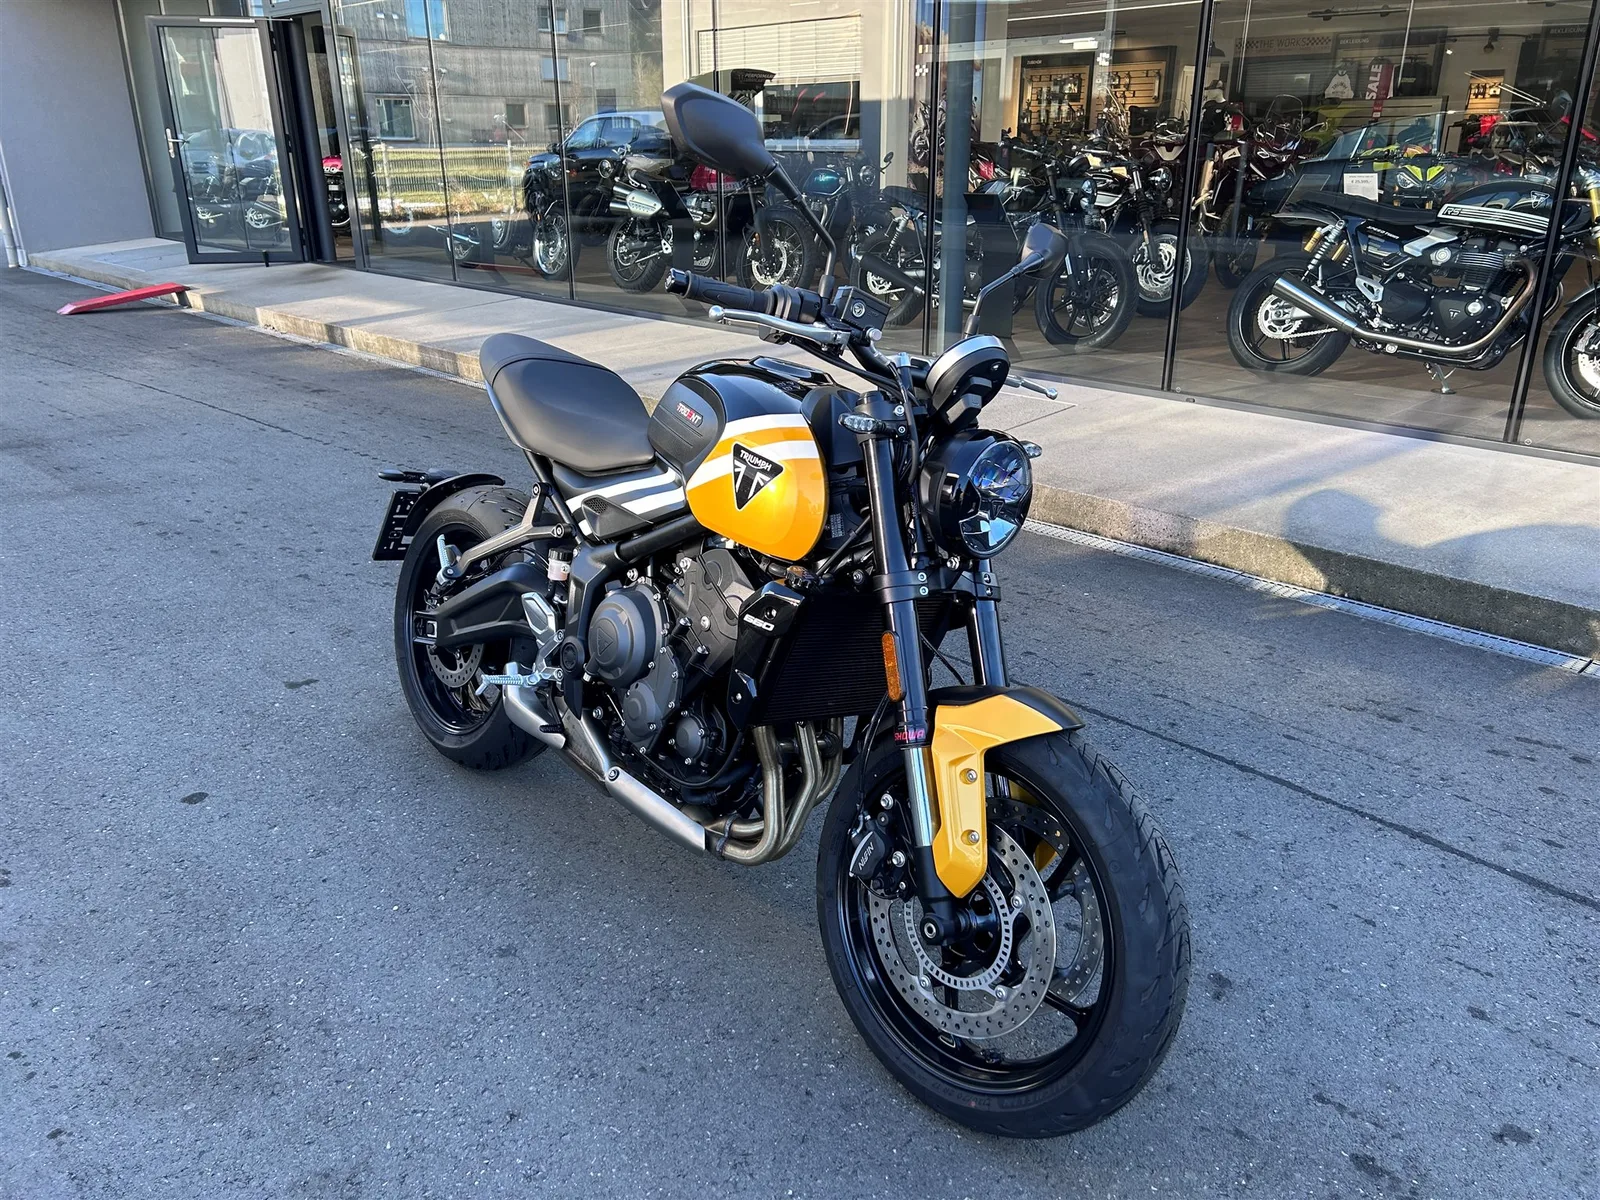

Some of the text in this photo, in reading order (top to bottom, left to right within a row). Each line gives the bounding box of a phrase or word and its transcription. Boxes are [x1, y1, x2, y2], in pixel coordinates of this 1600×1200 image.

[1259, 37, 1307, 48] THE WORKS
[1365, 64, 1383, 100] SALE
[1443, 207, 1462, 216] RS
[676, 402, 702, 424] TRIDENT
[739, 449, 772, 472] TRIUMPH
[743, 613, 775, 632] 660
[894, 728, 925, 741] SHOWA
[858, 841, 874, 871] NISSIN
